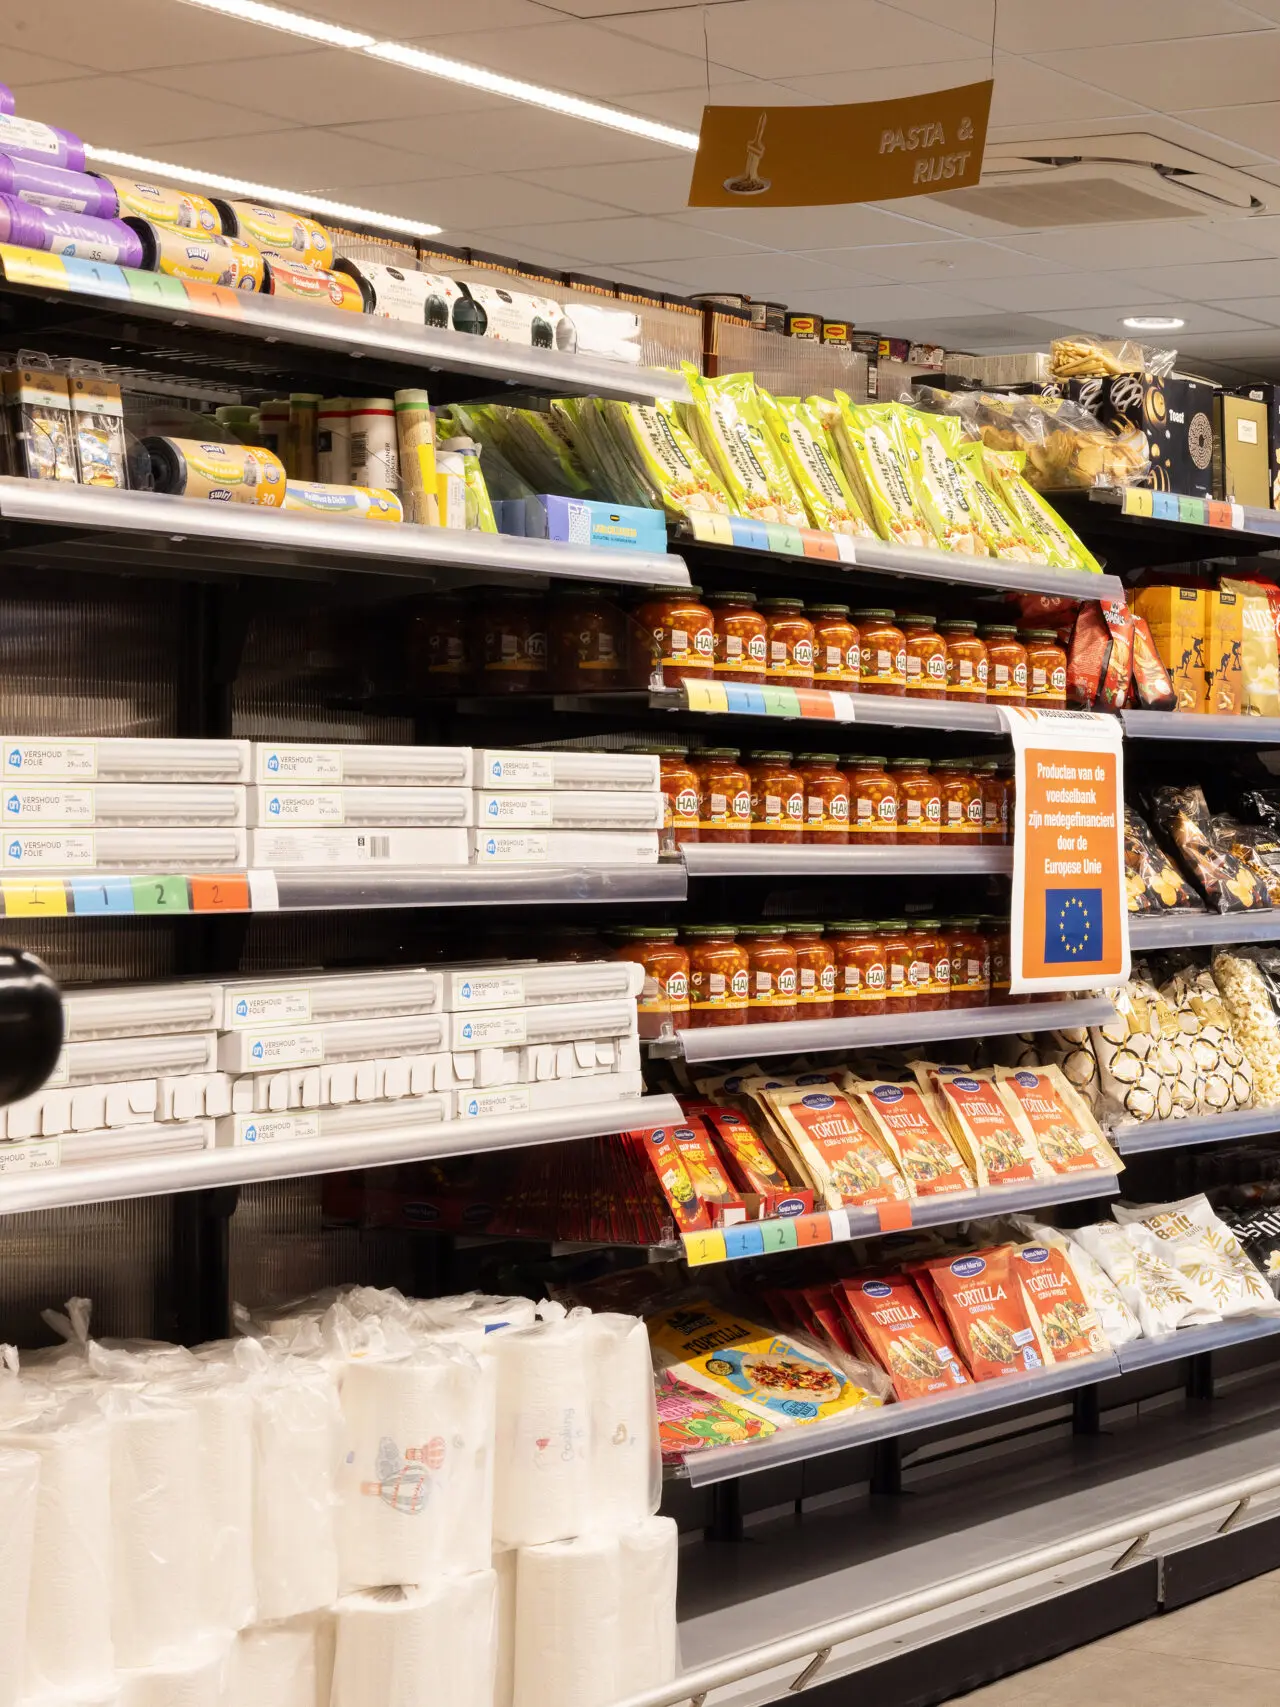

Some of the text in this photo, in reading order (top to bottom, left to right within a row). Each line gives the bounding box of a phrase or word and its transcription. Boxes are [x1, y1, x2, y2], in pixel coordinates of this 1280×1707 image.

[879, 116, 974, 154] PASTA &
[912, 151, 971, 184] RIJST
[186, 247, 210, 261] swirl
[1169, 408, 1185, 425] Toast
[658, 415, 691, 468] GLUTEN FREE
[208, 488, 232, 501] swirl
[260, 493, 275, 505] 30
[24, 750, 62, 758] VERSHOUD
[24, 758, 43, 766] FOLIE
[1037, 762, 1105, 781] Producten van de
[22, 796, 60, 804] VERSHOUD
[1046, 788, 1096, 804] voedselbank
[22, 804, 42, 812] FOLIE
[1028, 810, 1114, 830] zijn medegefinancierd
[24, 841, 62, 849] VERSHOUD
[1057, 835, 1087, 850] door de
[24, 849, 43, 857] FOLIE
[1044, 858, 1102, 876] Europese Unie
[28, 884, 223, 906] 1 1 2 2
[471, 981, 499, 989] VERSHOUD
[249, 998, 282, 1007] VERSHOUD
[249, 1006, 265, 1014] FOLIE
[473, 1021, 501, 1029] VERSHOUD
[264, 1039, 296, 1048] VERSHOUD
[264, 1048, 281, 1056] FOLIE
[479, 1097, 507, 1105] VERSHOUD
[1021, 1098, 1061, 1113] TORTILLA
[961, 1102, 1004, 1117] TORTILLA
[258, 1122, 291, 1131] VERSHOUD
[882, 1113, 929, 1129] TORTILLA
[258, 1131, 275, 1139] FOLIE
[808, 1119, 862, 1140] TORTILLA
[841, 1134, 863, 1145] WHEAT
[778, 1203, 802, 1213] Santa Maria
[776, 1228, 786, 1245] 2
[810, 1222, 819, 1239] 2
[1155, 1214, 1194, 1240] Ball!
[1185, 1225, 1203, 1238] Balls
[953, 1260, 982, 1271] Santa Maria
[1026, 1272, 1072, 1293] TORTILLA
[953, 1284, 1007, 1307] TORTILLA
[871, 1305, 921, 1326] TORTILLA
[969, 1304, 996, 1315] ORIGINAL
[889, 1321, 915, 1332] ORIGINAL
[682, 1324, 751, 1356] TORTILLA
